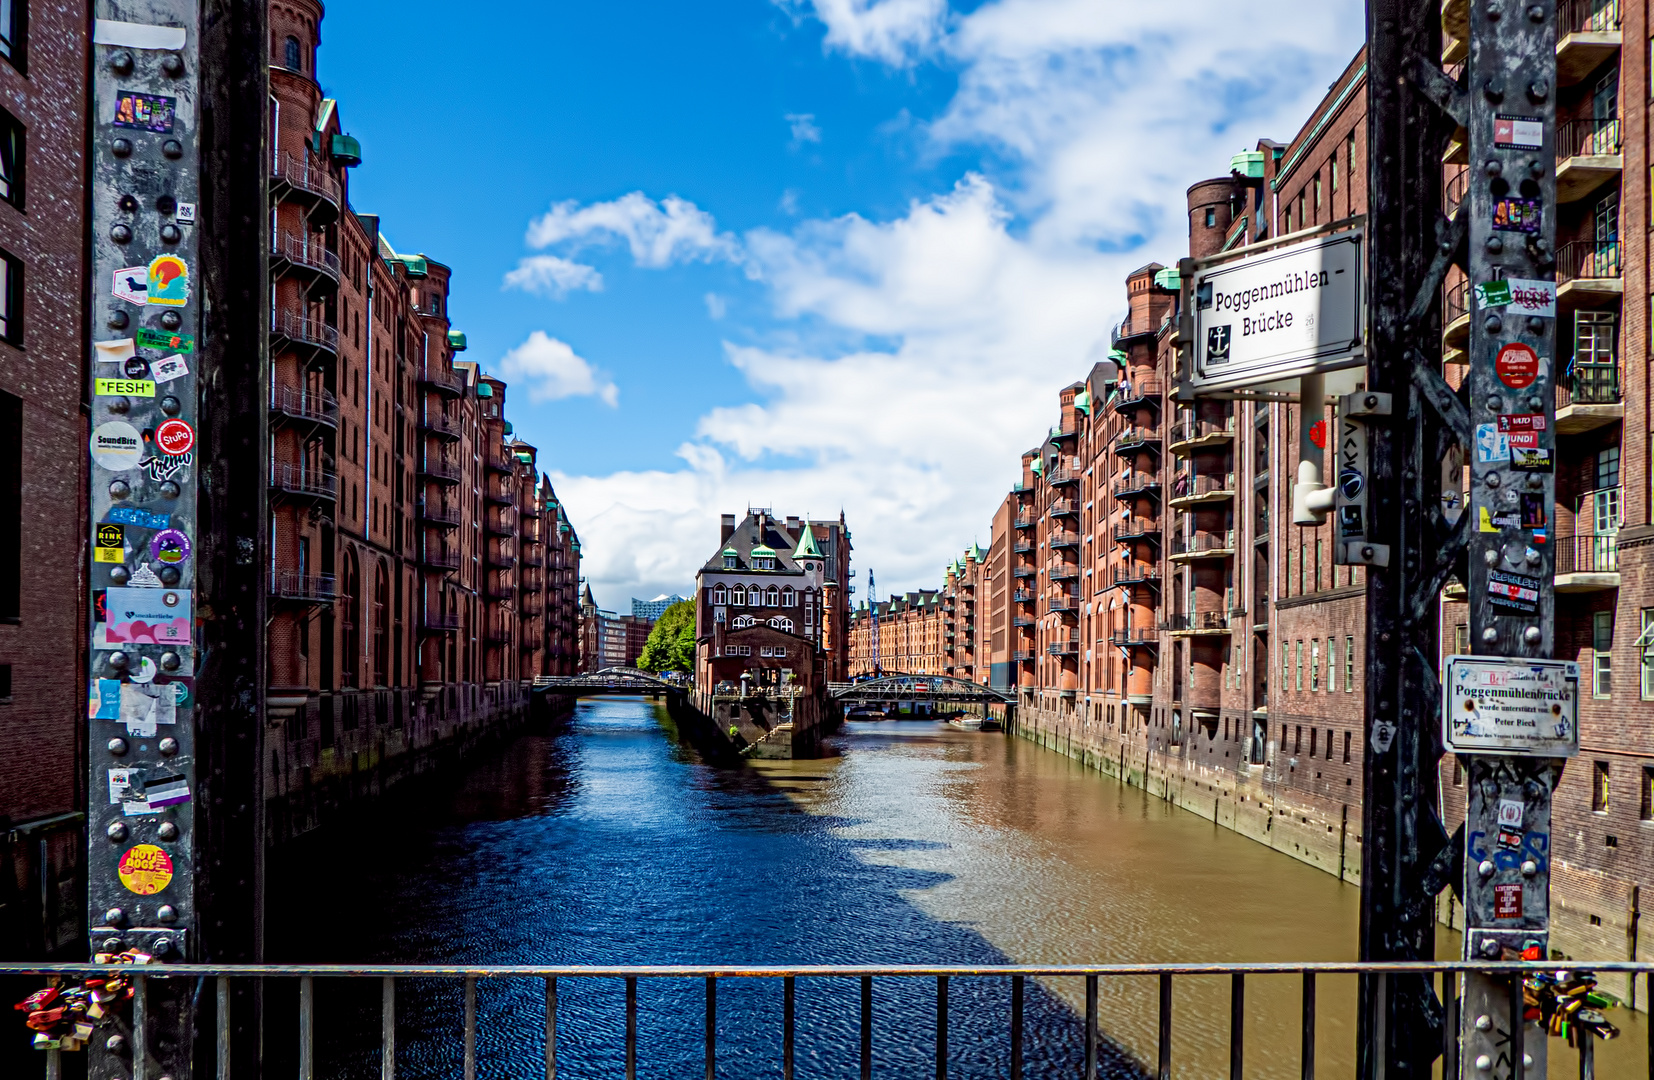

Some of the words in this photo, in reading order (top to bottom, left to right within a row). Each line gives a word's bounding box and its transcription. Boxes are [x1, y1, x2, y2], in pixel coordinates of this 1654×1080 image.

[1215, 270, 1329, 312] Poggenmühlen
[1242, 310, 1294, 337] Brücke
[97, 435, 138, 446] SoundBite
[163, 431, 189, 445] StuPa
[98, 532, 122, 540] RINK
[1456, 685, 1571, 701] Poggenmühlenbrücke
[1495, 717, 1514, 726] Peter
[130, 849, 153, 860] HOT
[126, 858, 154, 870] DOGS
